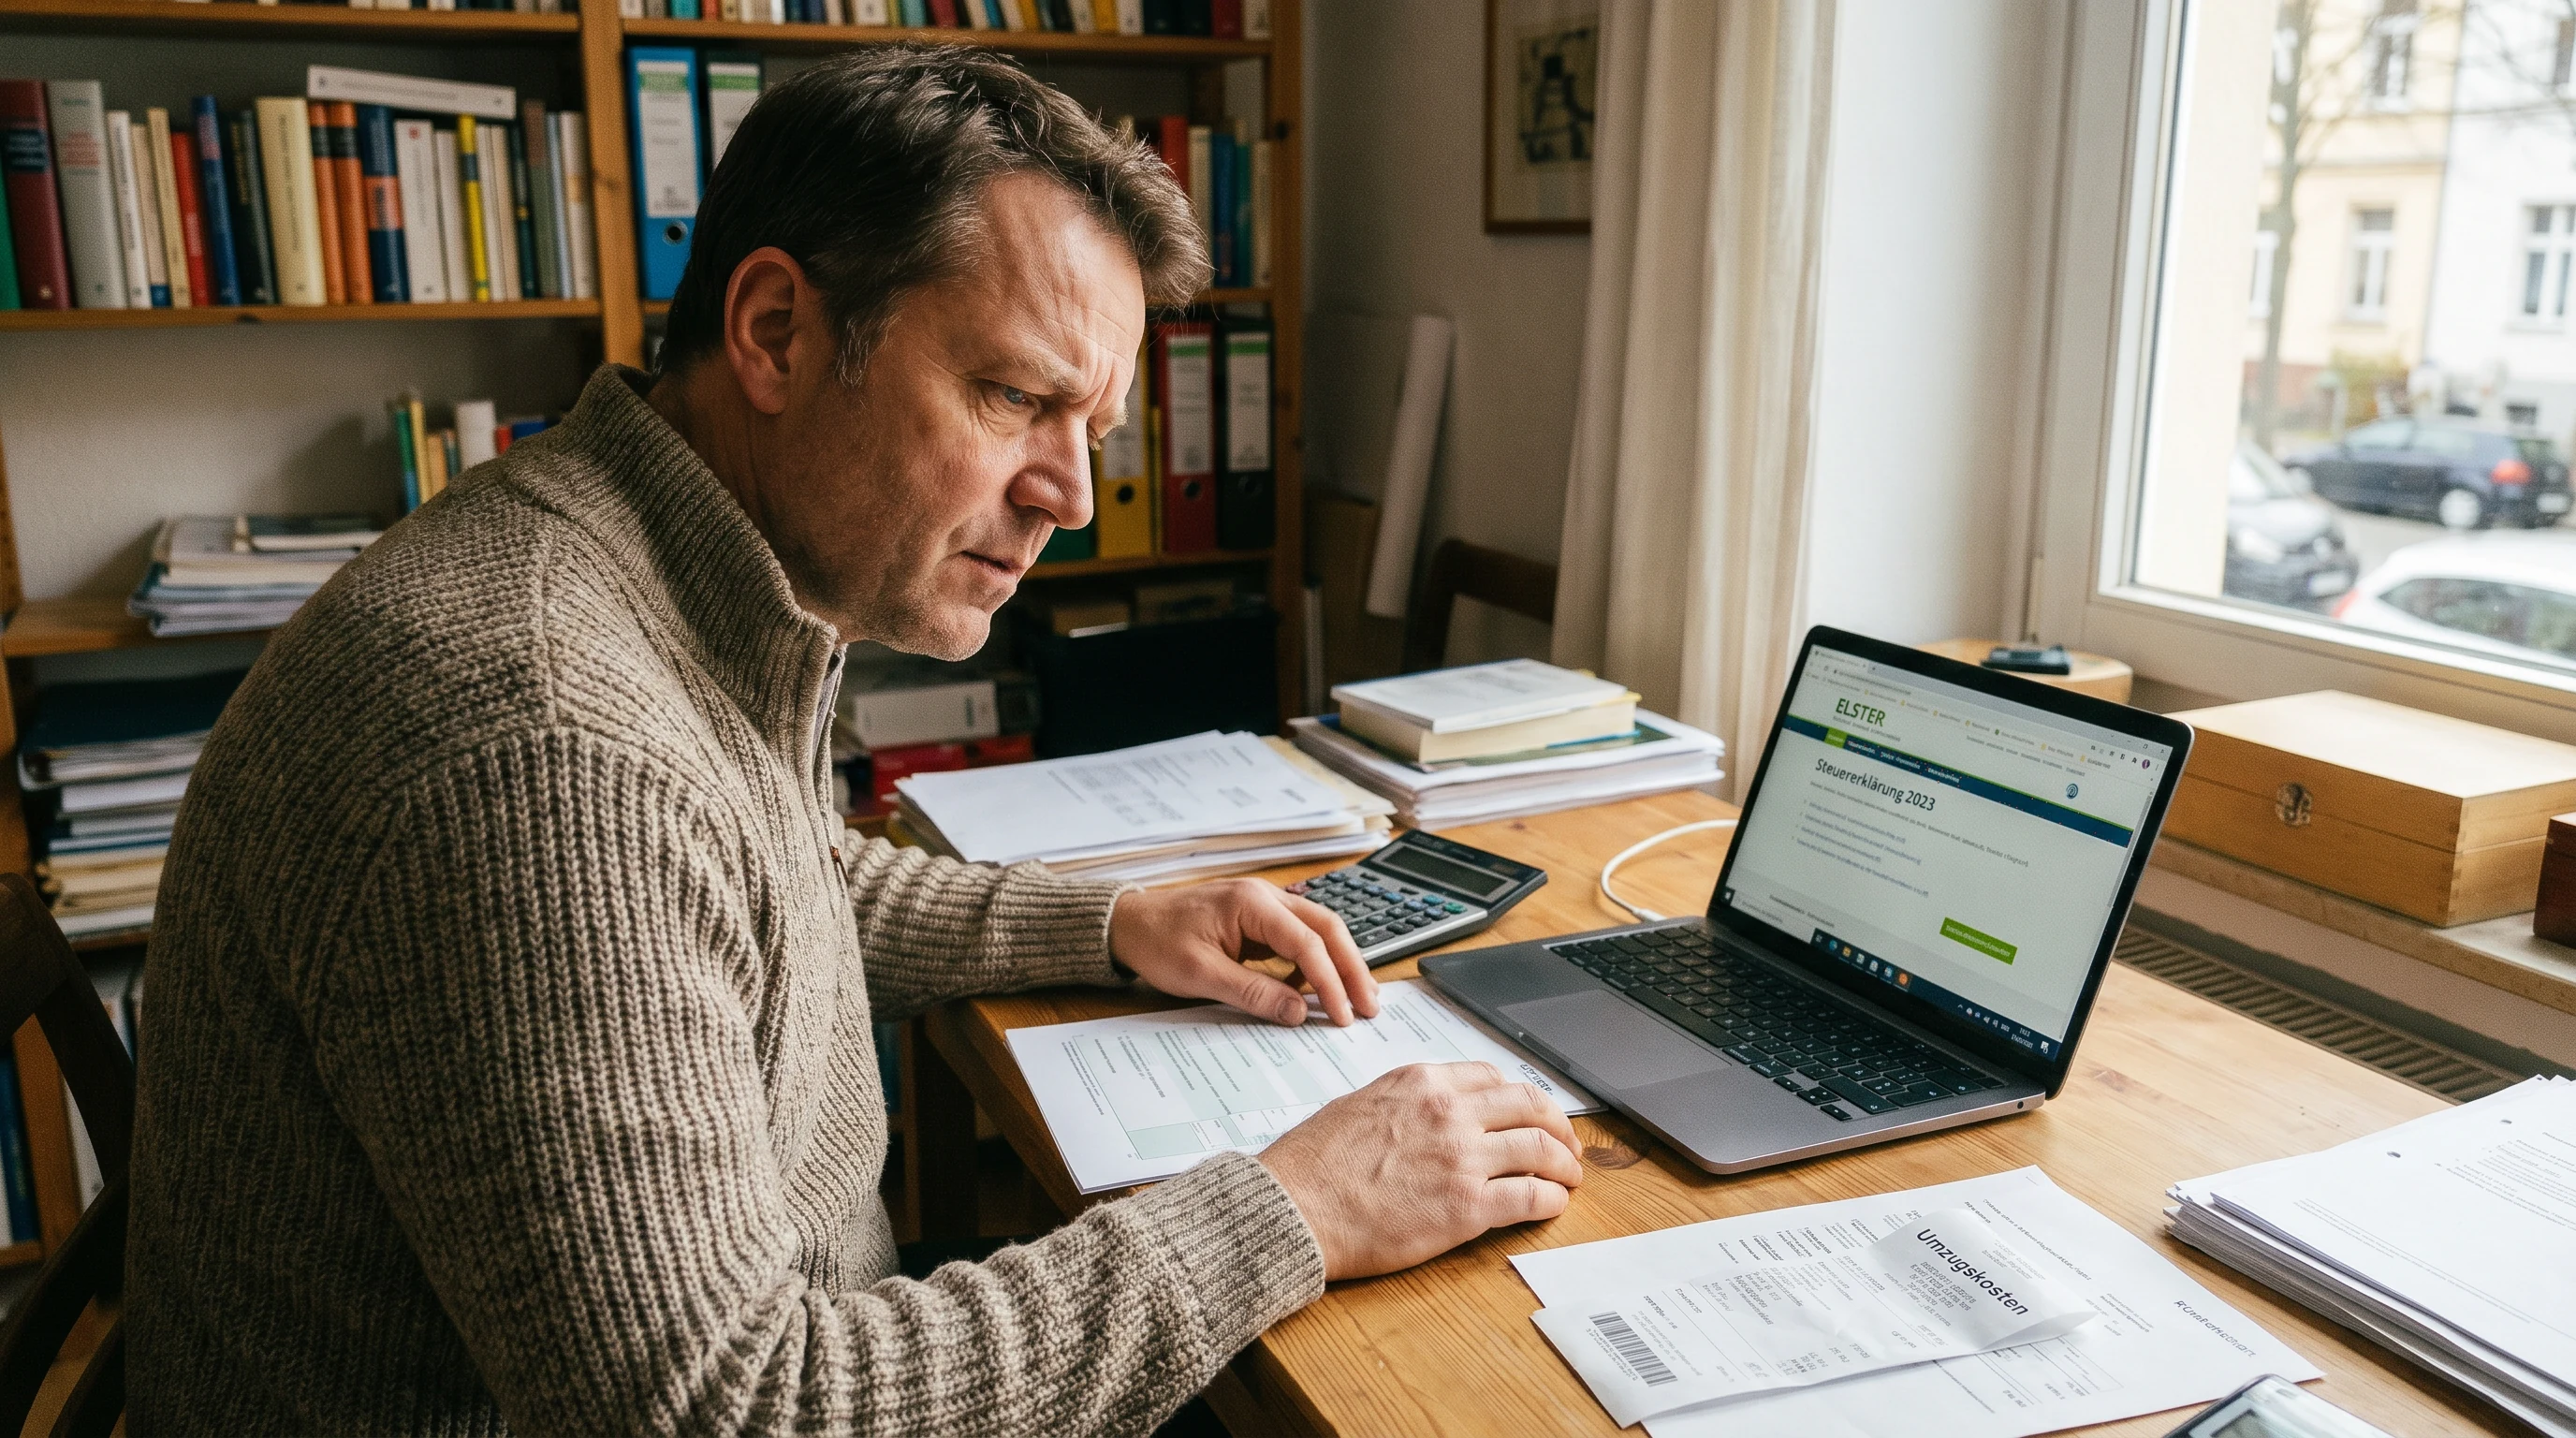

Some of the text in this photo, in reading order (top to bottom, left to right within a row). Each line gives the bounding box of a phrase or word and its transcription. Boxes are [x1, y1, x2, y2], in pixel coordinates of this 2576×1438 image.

[1836, 697, 1886, 727] ELSTER
[1815, 758, 1905, 804] Steuererklärung
[1905, 790, 1937, 812] 2023
[1916, 1228, 2029, 1316] Umzugskosten
